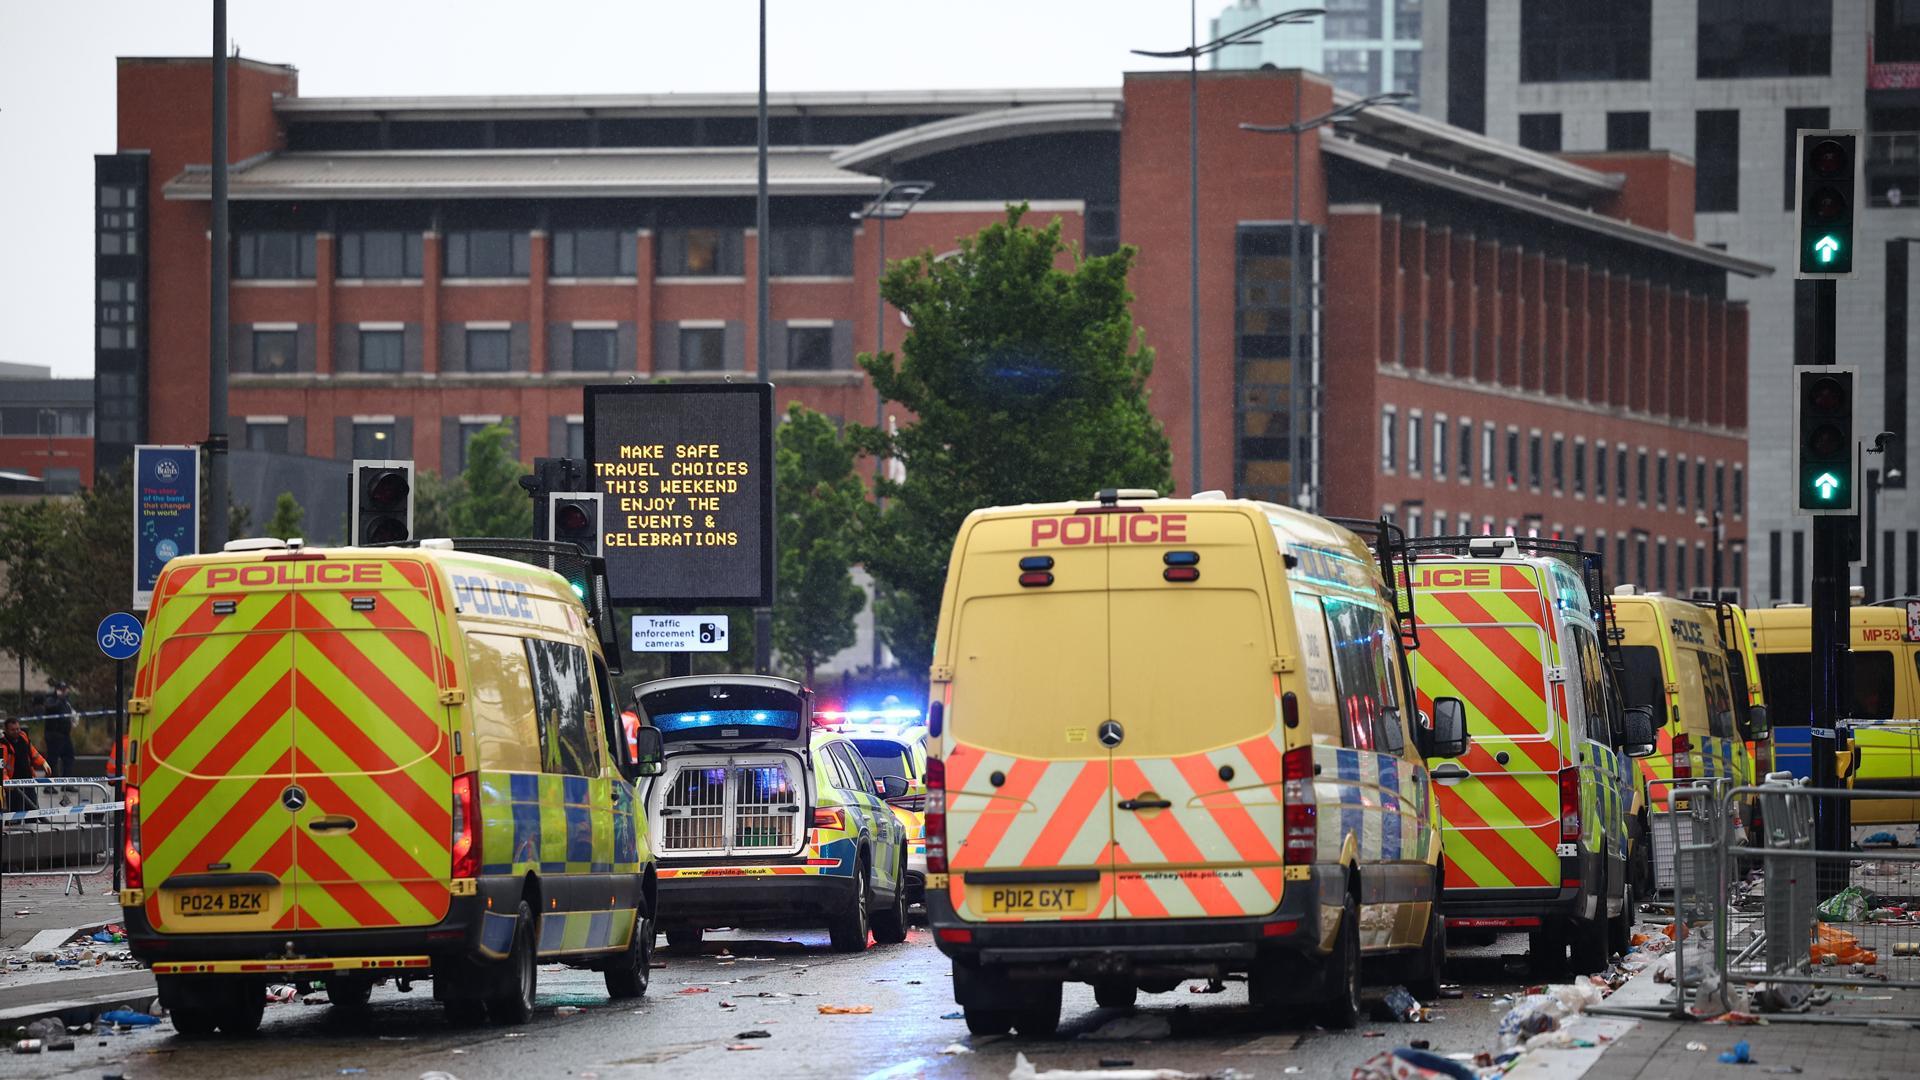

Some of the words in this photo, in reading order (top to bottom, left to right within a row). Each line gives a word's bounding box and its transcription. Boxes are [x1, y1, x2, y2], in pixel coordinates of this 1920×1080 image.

[620, 445, 664, 459] MAKE
[676, 445, 720, 459] SAFE
[594, 463, 660, 477] TRAVEL
[671, 462, 749, 476] CHOICES
[605, 480, 649, 494] THIS
[660, 479, 738, 493] WEEKEND
[621, 498, 676, 511] ENJOY
[688, 497, 720, 511] THE
[627, 515, 693, 529] EVENTS
[705, 515, 715, 528] &
[1031, 514, 1187, 547] POLICE
[605, 532, 738, 546] CELEBRATIONS
[206, 563, 383, 588] POLICE
[1397, 569, 1490, 587] LICE
[451, 575, 533, 619] POLICE
[649, 619, 680, 628] Traffic
[635, 629, 695, 638] enforcement
[681, 868, 766, 876] www.merseyside.police.uk
[1119, 870, 1243, 881] www.merseyside.police.uk
[181, 895, 224, 911] PO24
[229, 893, 262, 909] BZK
[1039, 889, 1076, 908] GXT
